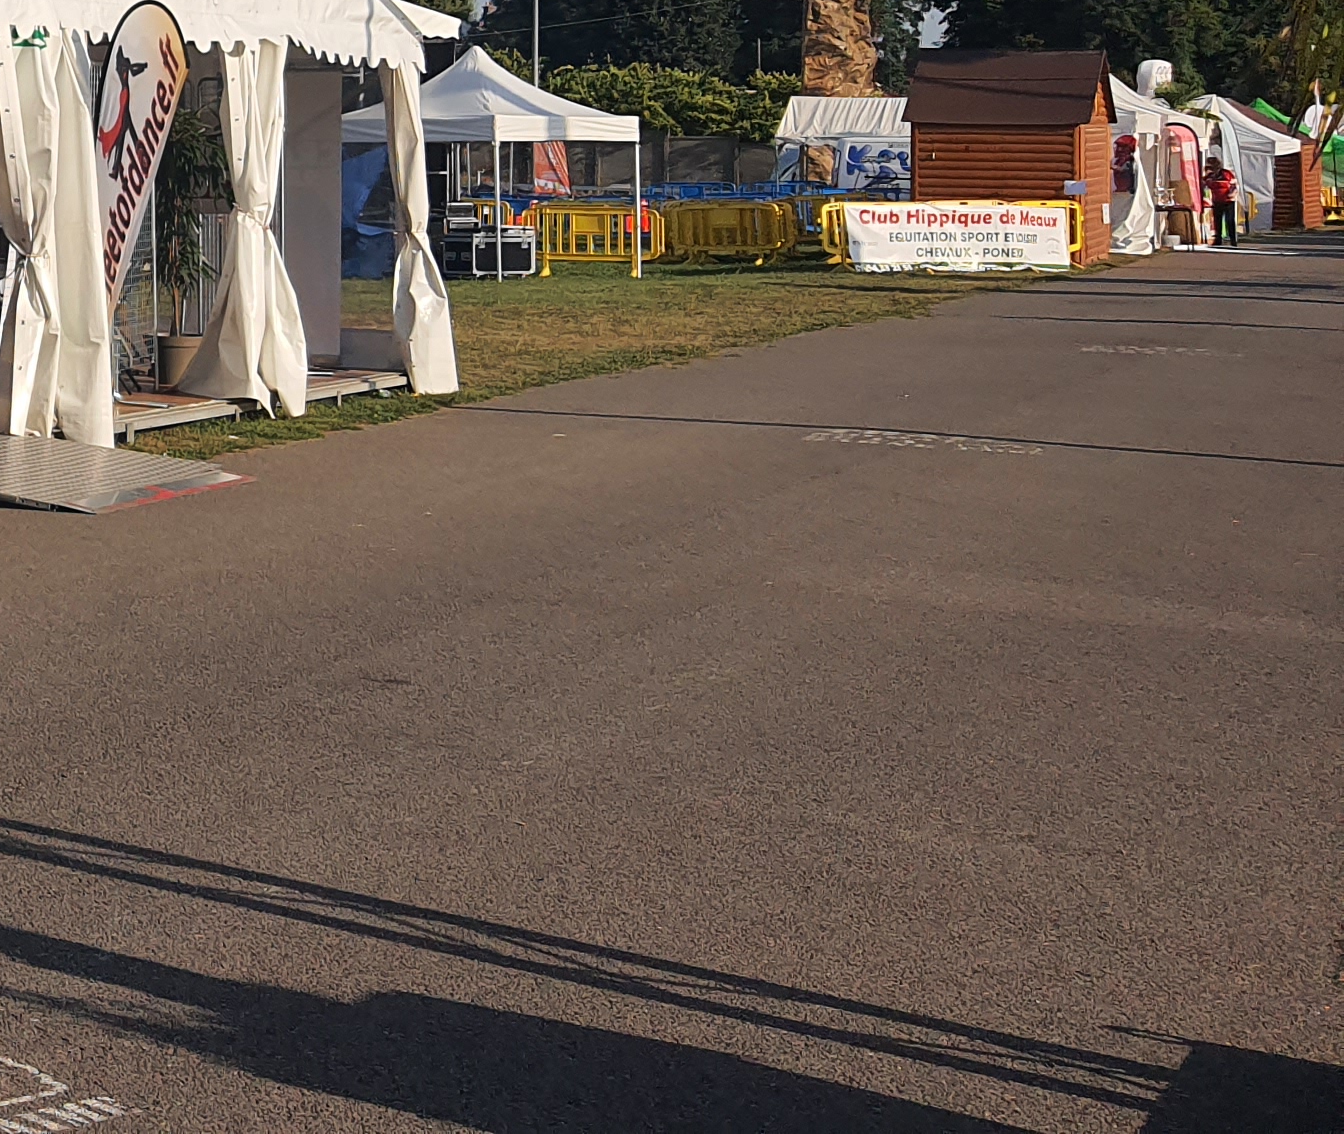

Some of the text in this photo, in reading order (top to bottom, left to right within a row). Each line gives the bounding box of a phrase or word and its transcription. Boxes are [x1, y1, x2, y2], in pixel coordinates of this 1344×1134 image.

[859, 209, 1058, 228] Club Hippique de Meaux
[889, 232, 957, 243] EQUITATION
[960, 232, 1000, 243] SPORT
[1004, 232, 1015, 243] ET
[916, 247, 972, 258] CHEVAUX
